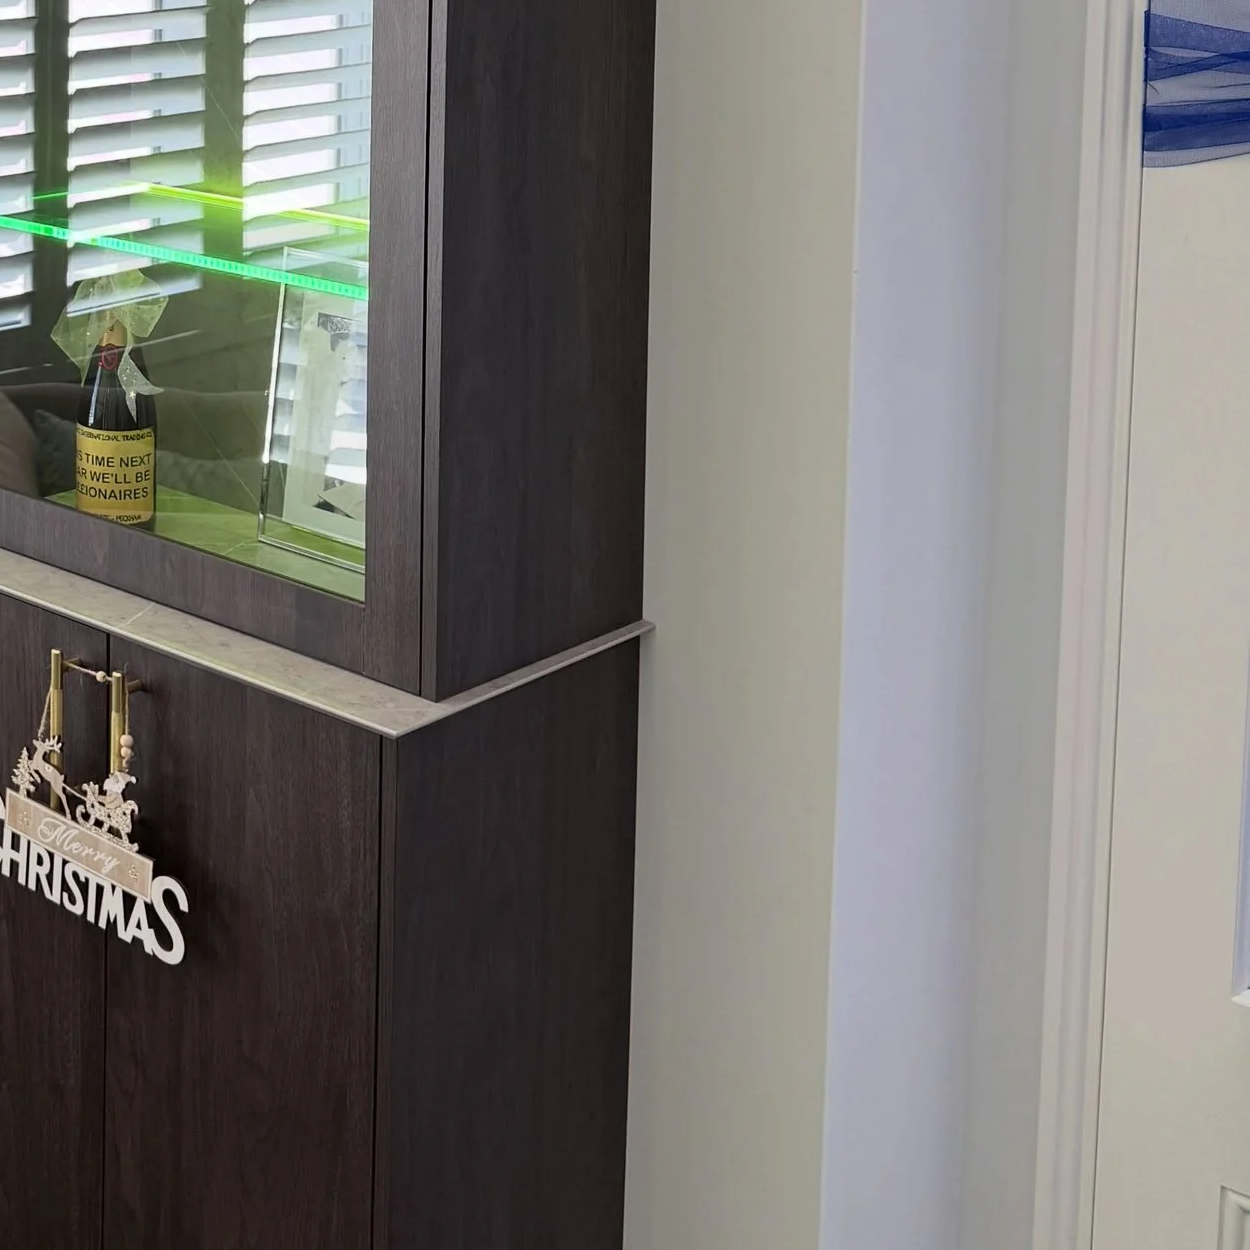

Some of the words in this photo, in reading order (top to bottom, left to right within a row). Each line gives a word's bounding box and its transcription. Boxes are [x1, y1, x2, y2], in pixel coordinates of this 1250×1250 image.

[85, 452, 115, 468] TIME
[119, 453, 152, 468] NEXT
[90, 470, 131, 484] WE'LL
[135, 470, 151, 484] BE
[37, 817, 120, 873] Merry
